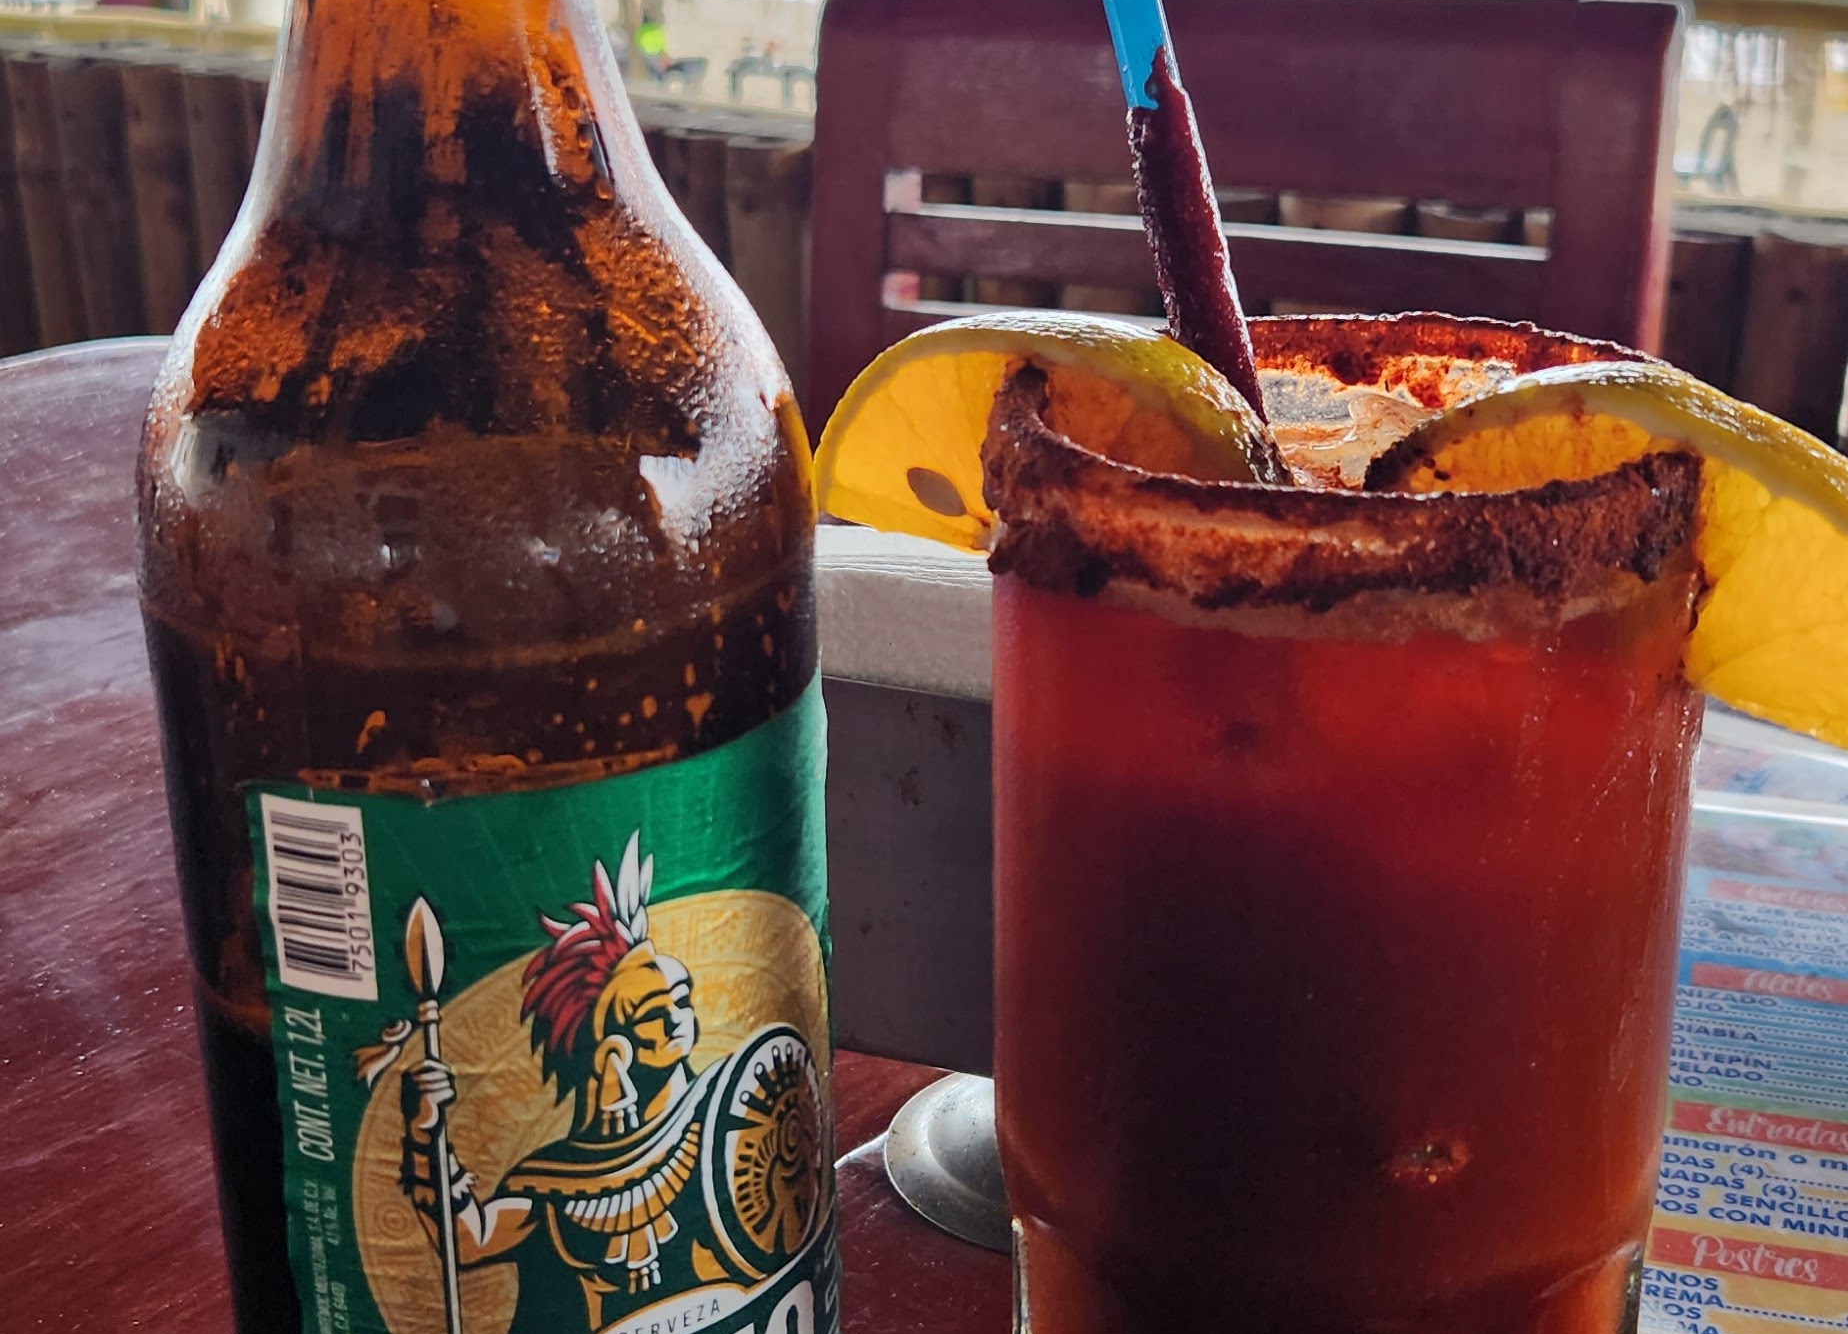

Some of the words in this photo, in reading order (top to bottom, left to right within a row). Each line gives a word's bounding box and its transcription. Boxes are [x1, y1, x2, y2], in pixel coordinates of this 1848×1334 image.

[340, 831, 367, 897] 9303
[350, 910, 373, 973] 7501
[289, 1051, 328, 1099] NET.
[293, 1100, 335, 1162] CONT.
[1730, 1161, 1765, 1180] (4)
[1788, 1153, 1808, 1165] o
[1657, 1182, 1701, 1199] OS
[1762, 1182, 1797, 1200] (4)
[1655, 1198, 1698, 1215] OS
[1708, 1207, 1771, 1227] CON
[1691, 1234, 1819, 1283] Postres
